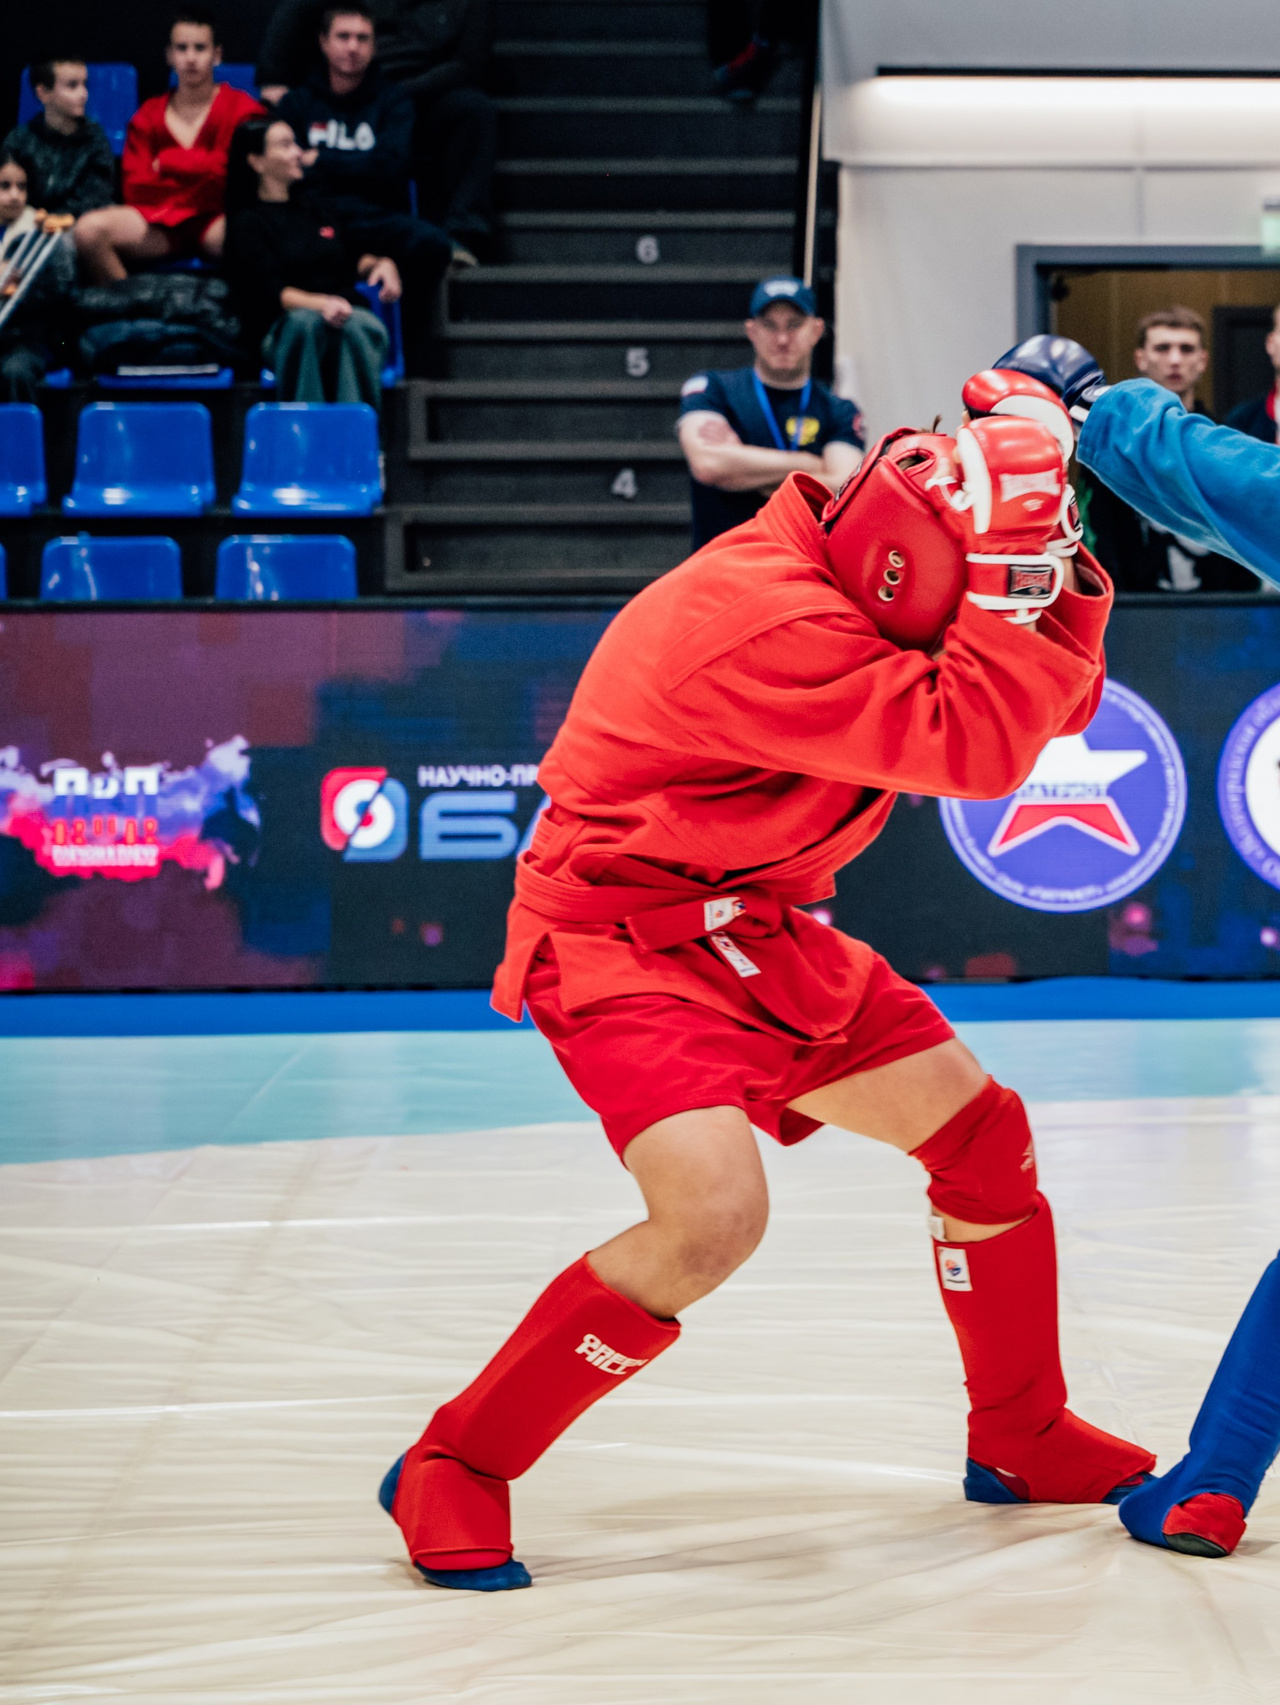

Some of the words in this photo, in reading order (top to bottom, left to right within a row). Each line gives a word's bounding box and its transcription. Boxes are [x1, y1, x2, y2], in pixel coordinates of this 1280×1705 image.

[636, 235, 660, 264] 6
[626, 347, 649, 377] 5
[611, 468, 637, 499] 4
[419, 790, 550, 860] Б
